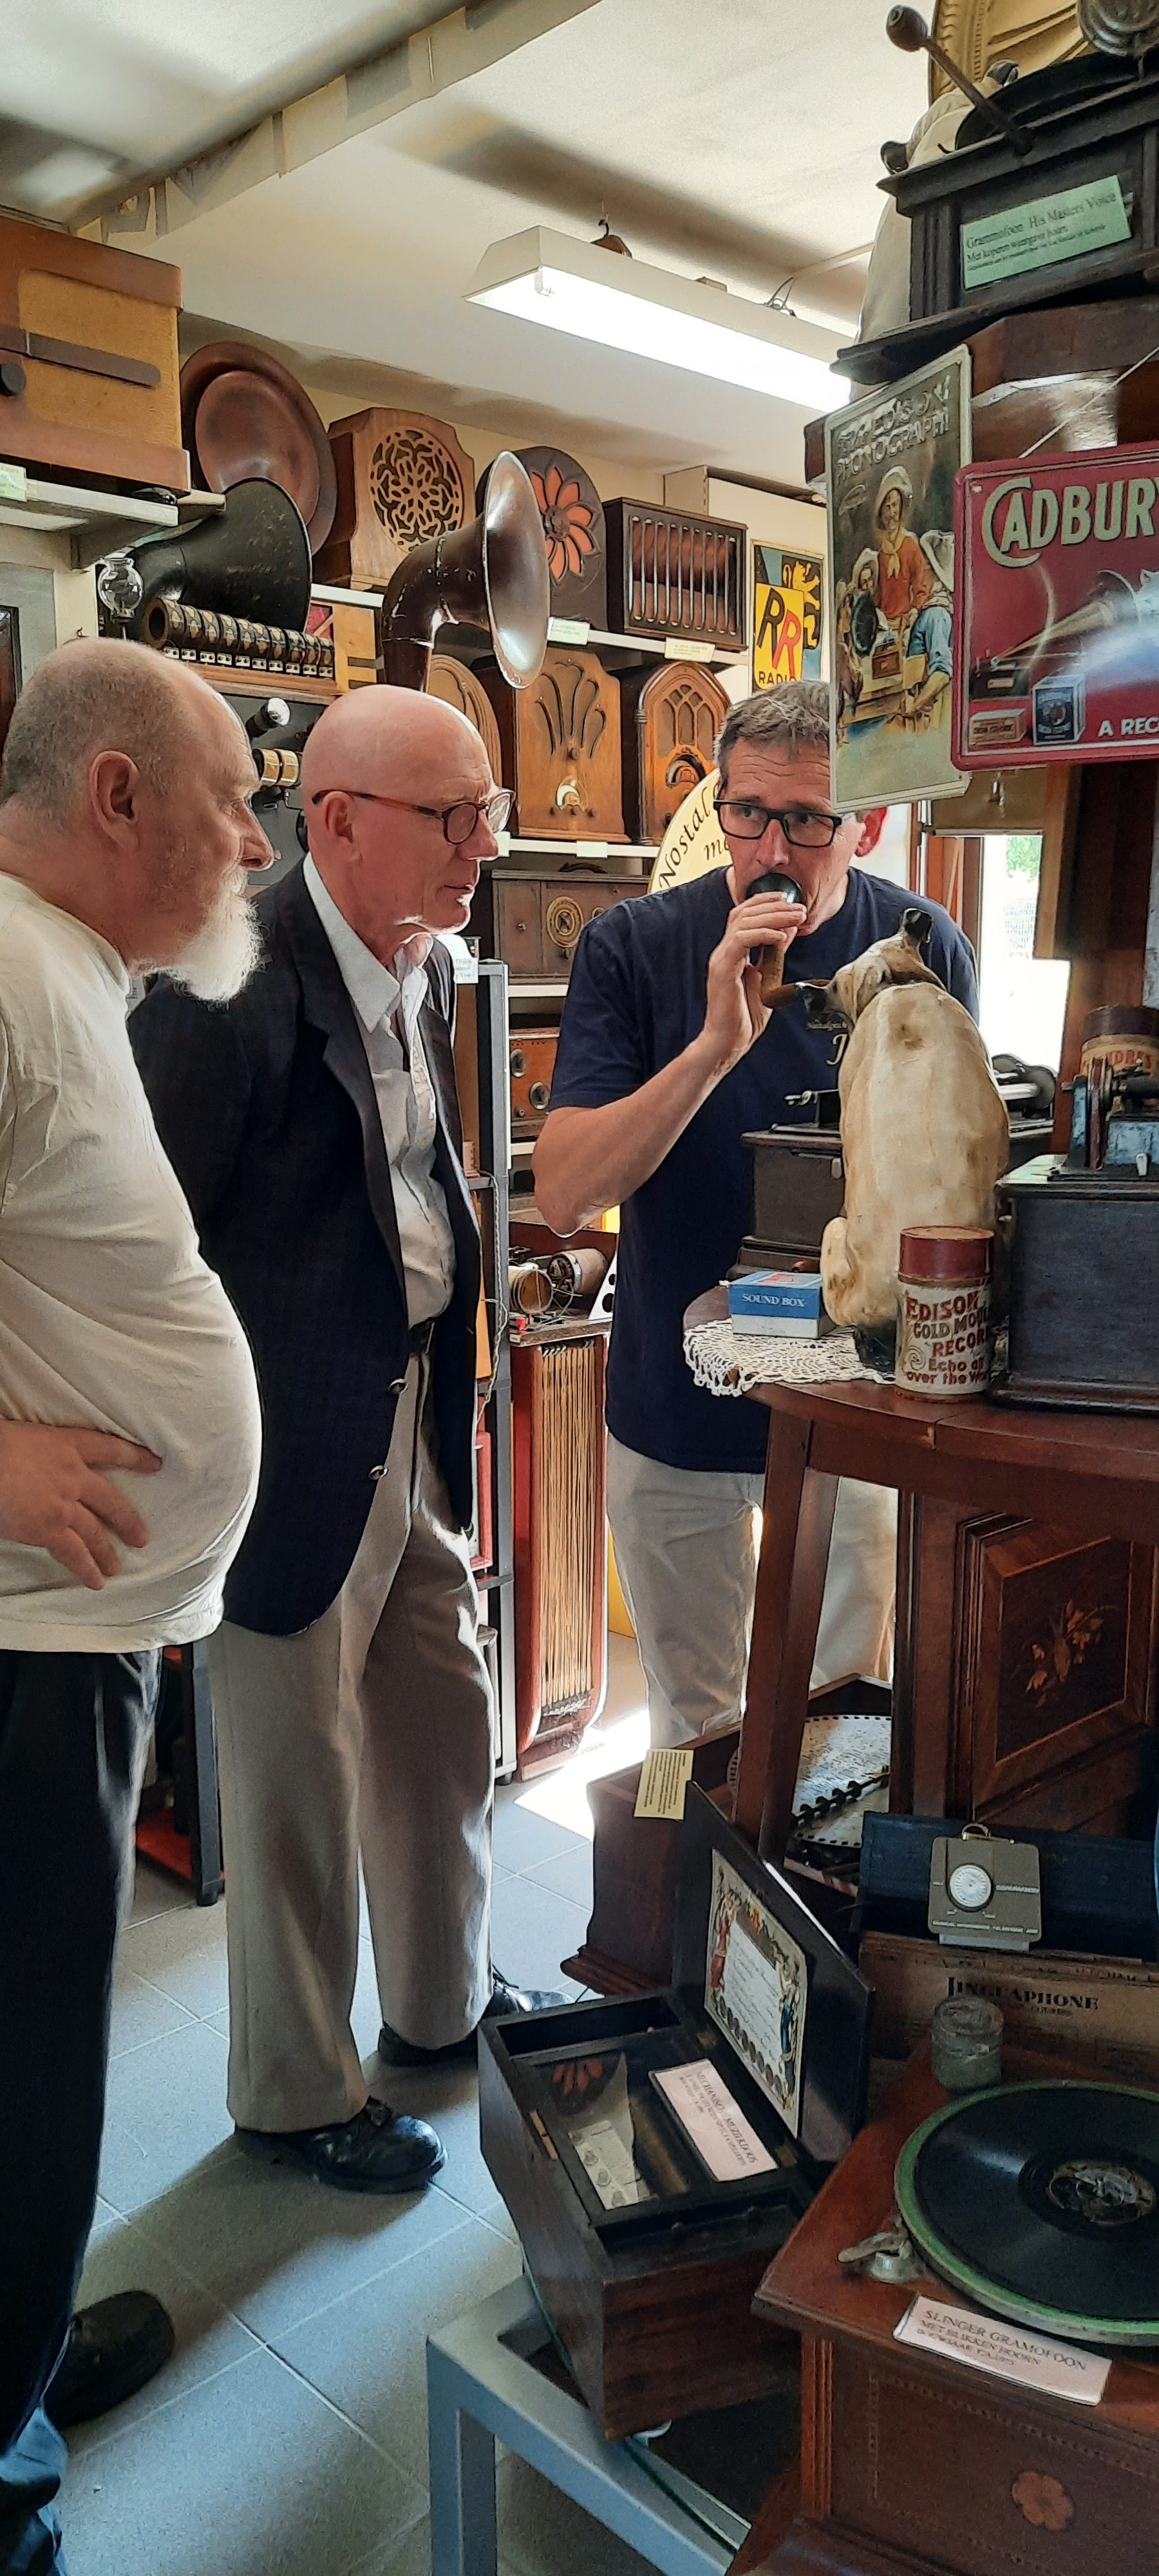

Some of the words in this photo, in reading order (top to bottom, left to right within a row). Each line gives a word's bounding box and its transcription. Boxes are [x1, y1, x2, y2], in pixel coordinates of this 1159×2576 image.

[1030, 214, 1046, 228] His
[982, 477, 1159, 567] CADBUR
[1098, 718, 1115, 738] A
[742, 1294, 780, 1305] SOUND
[781, 1297, 805, 1307] BOX
[906, 1290, 979, 1321] EDISON
[913, 1321, 950, 1340] GOLD
[928, 1358, 967, 1372] Echo
[906, 1370, 938, 1384] over
[942, 1372, 967, 1385] the
[925, 2309, 986, 2338] SLINGER
[989, 2331, 1086, 2371] GRAMOFOON
